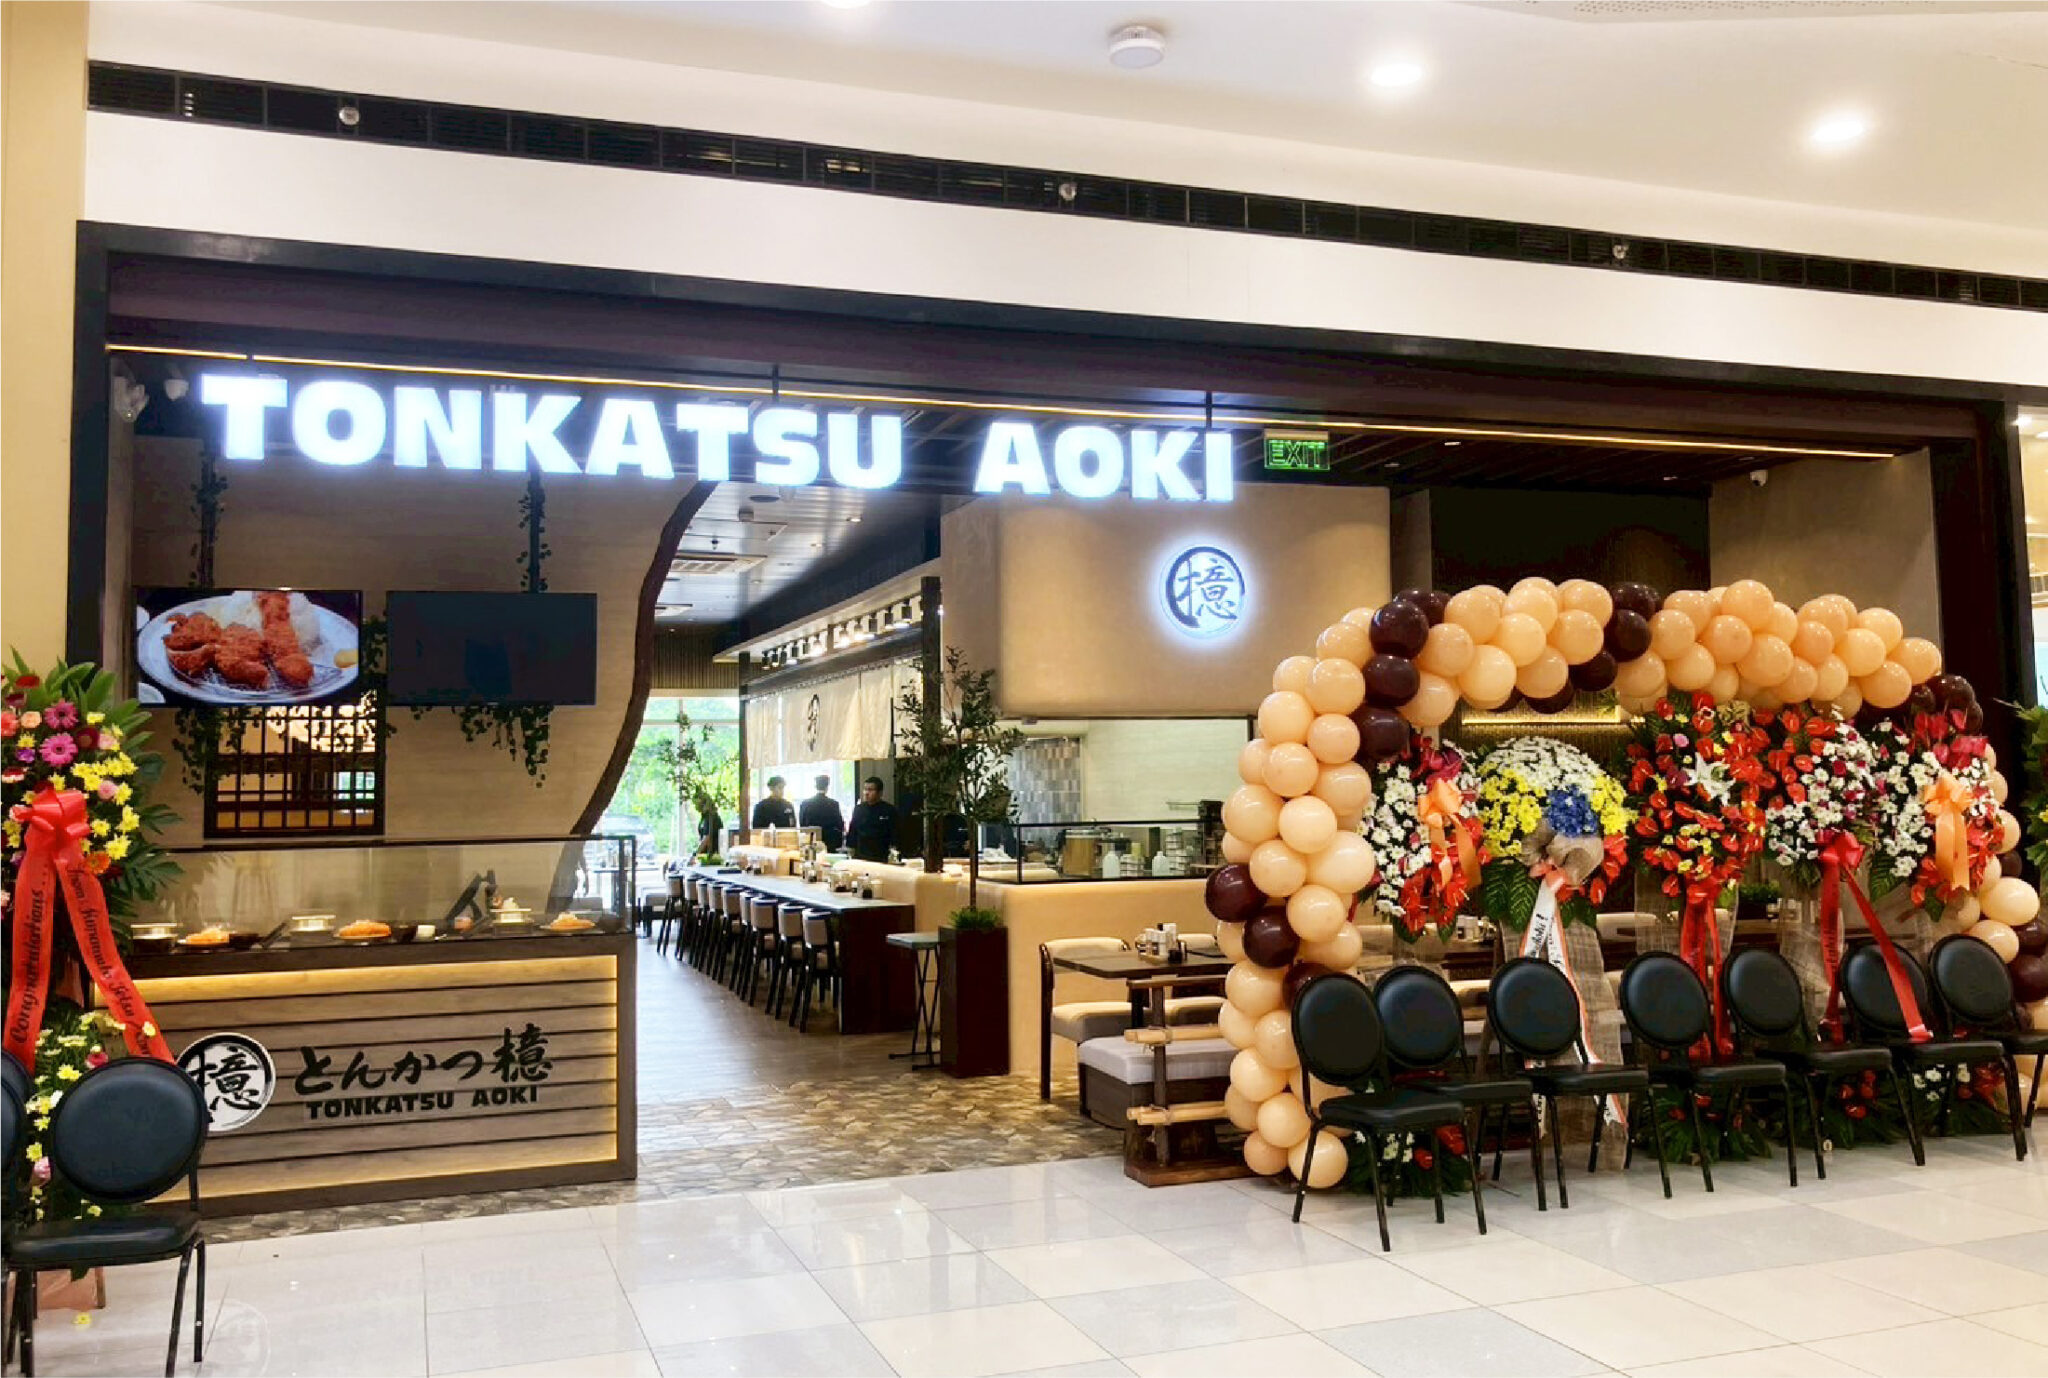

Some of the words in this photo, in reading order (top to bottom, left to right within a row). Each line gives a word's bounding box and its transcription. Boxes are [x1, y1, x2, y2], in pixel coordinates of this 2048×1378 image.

[201, 374, 902, 489] TONKATSU
[974, 422, 1234, 502] AOKI
[1269, 440, 1325, 469] EXIT
[306, 1090, 454, 1119] TONKATSU
[471, 1085, 537, 1107] AOKI
